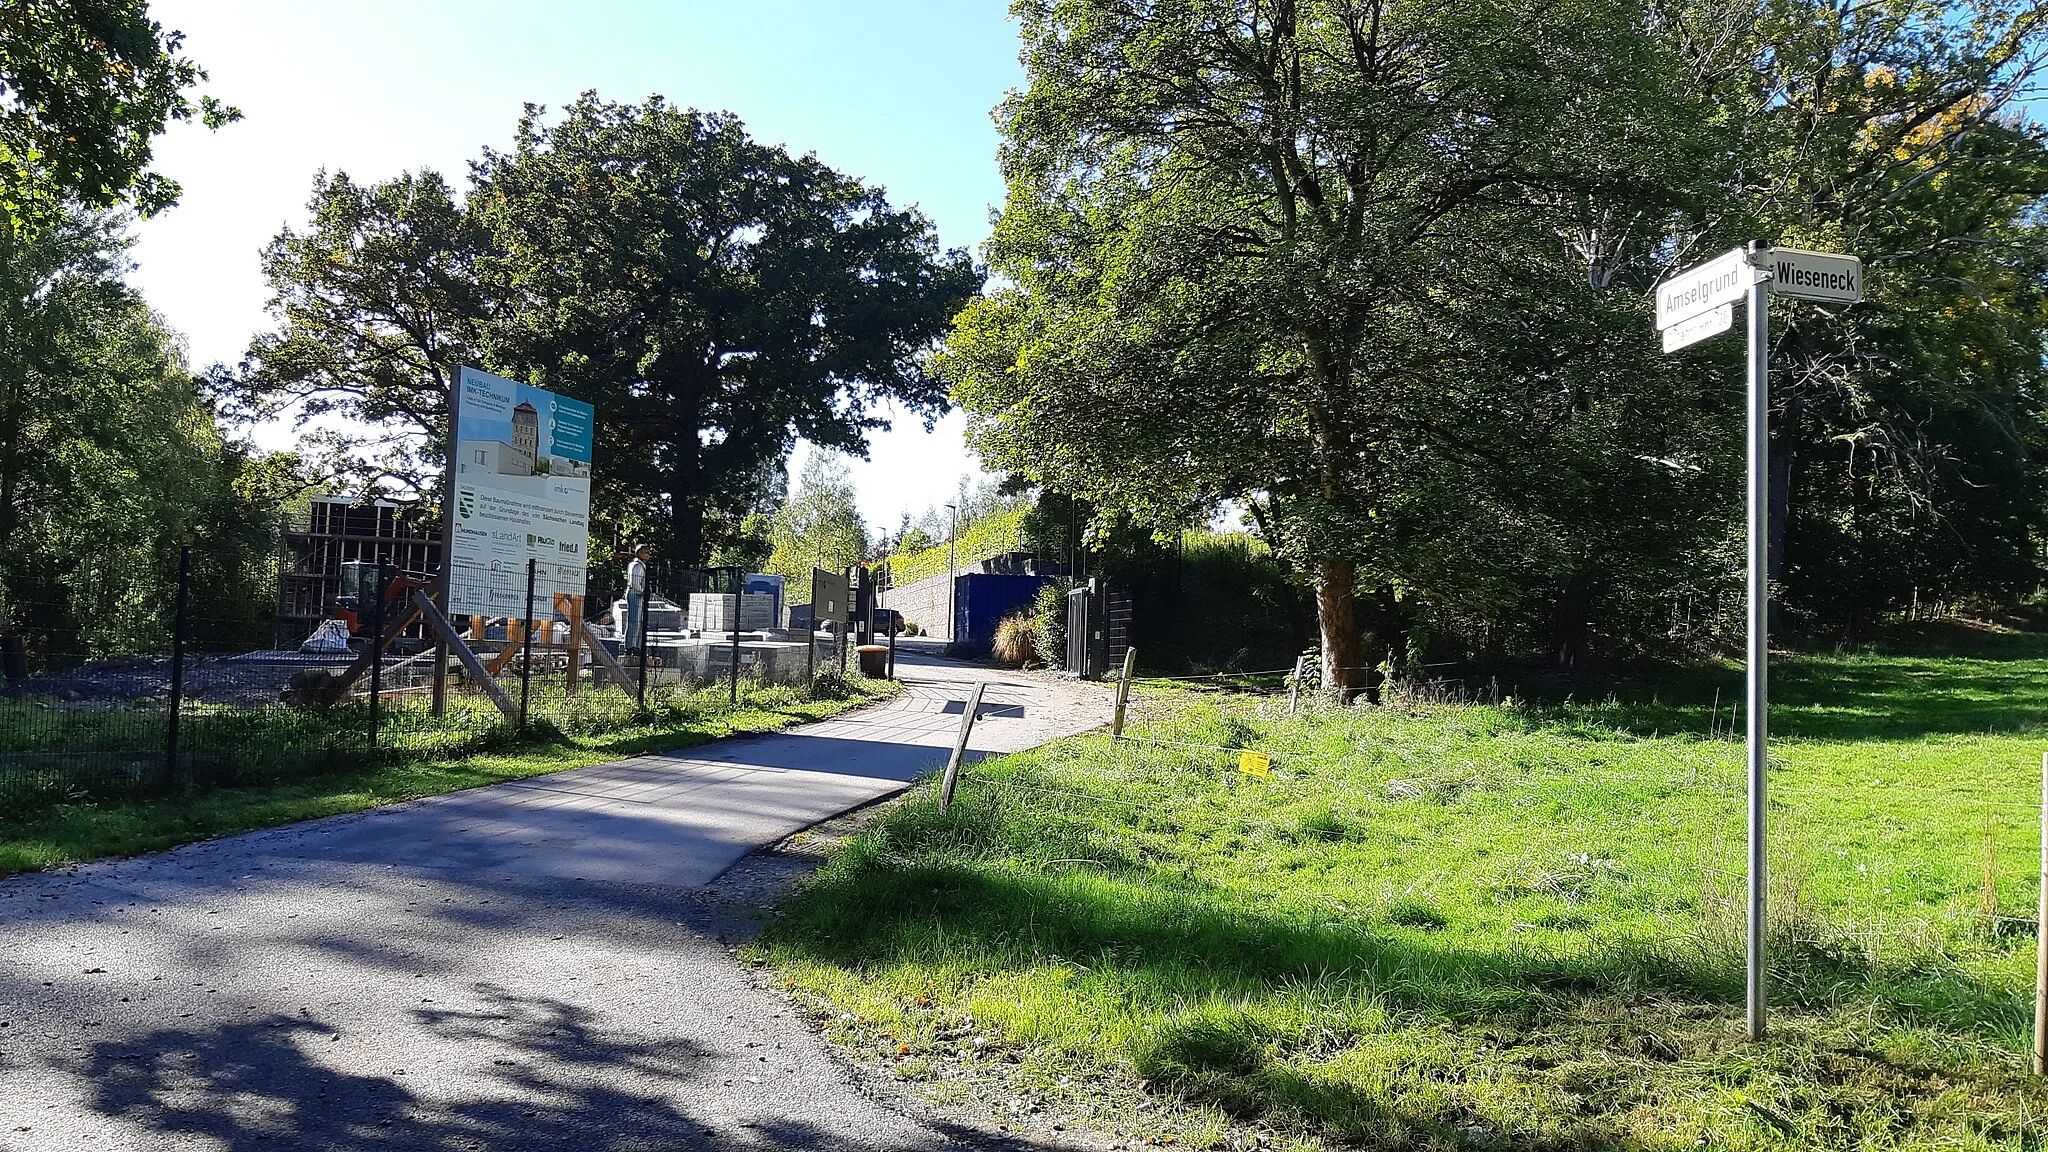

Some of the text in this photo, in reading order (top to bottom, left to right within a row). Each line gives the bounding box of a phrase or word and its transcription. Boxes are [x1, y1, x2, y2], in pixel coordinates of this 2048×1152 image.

[1777, 261, 1855, 292] Wieseneck
[1666, 264, 1738, 314] Amselgrund
[467, 378, 490, 390] NEUBAU
[466, 386, 510, 403] IMK-TECHNIKUM
[491, 530, 521, 543] sLandArt
